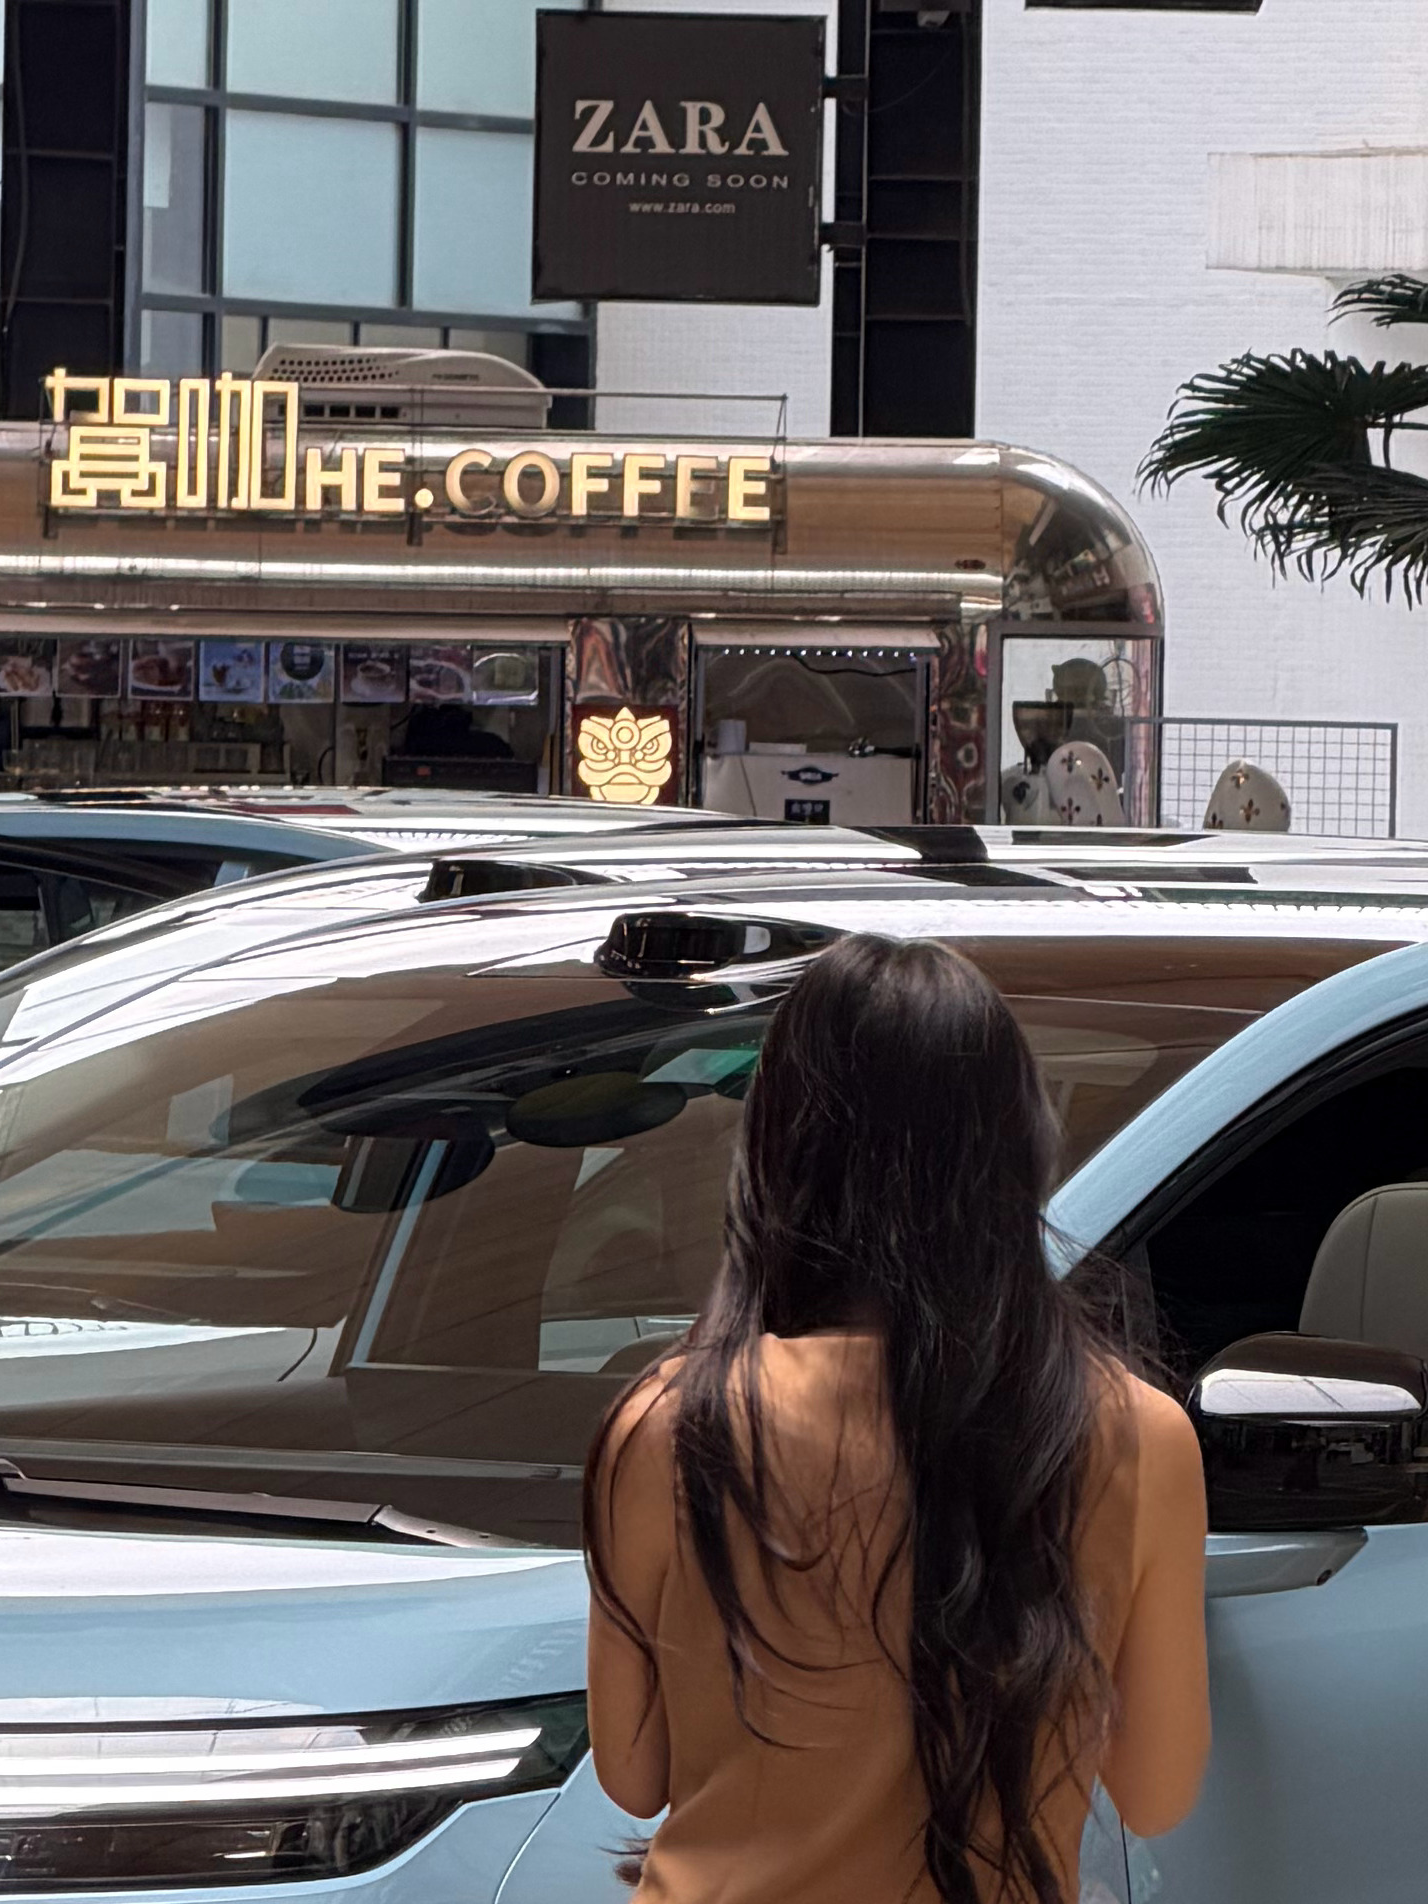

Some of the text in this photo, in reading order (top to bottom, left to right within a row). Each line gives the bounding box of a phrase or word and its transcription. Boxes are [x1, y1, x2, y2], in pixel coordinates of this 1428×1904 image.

[572, 99, 790, 157] ZARA
[571, 171, 790, 190] COMING SOON
[628, 201, 737, 215] www.zara.com
